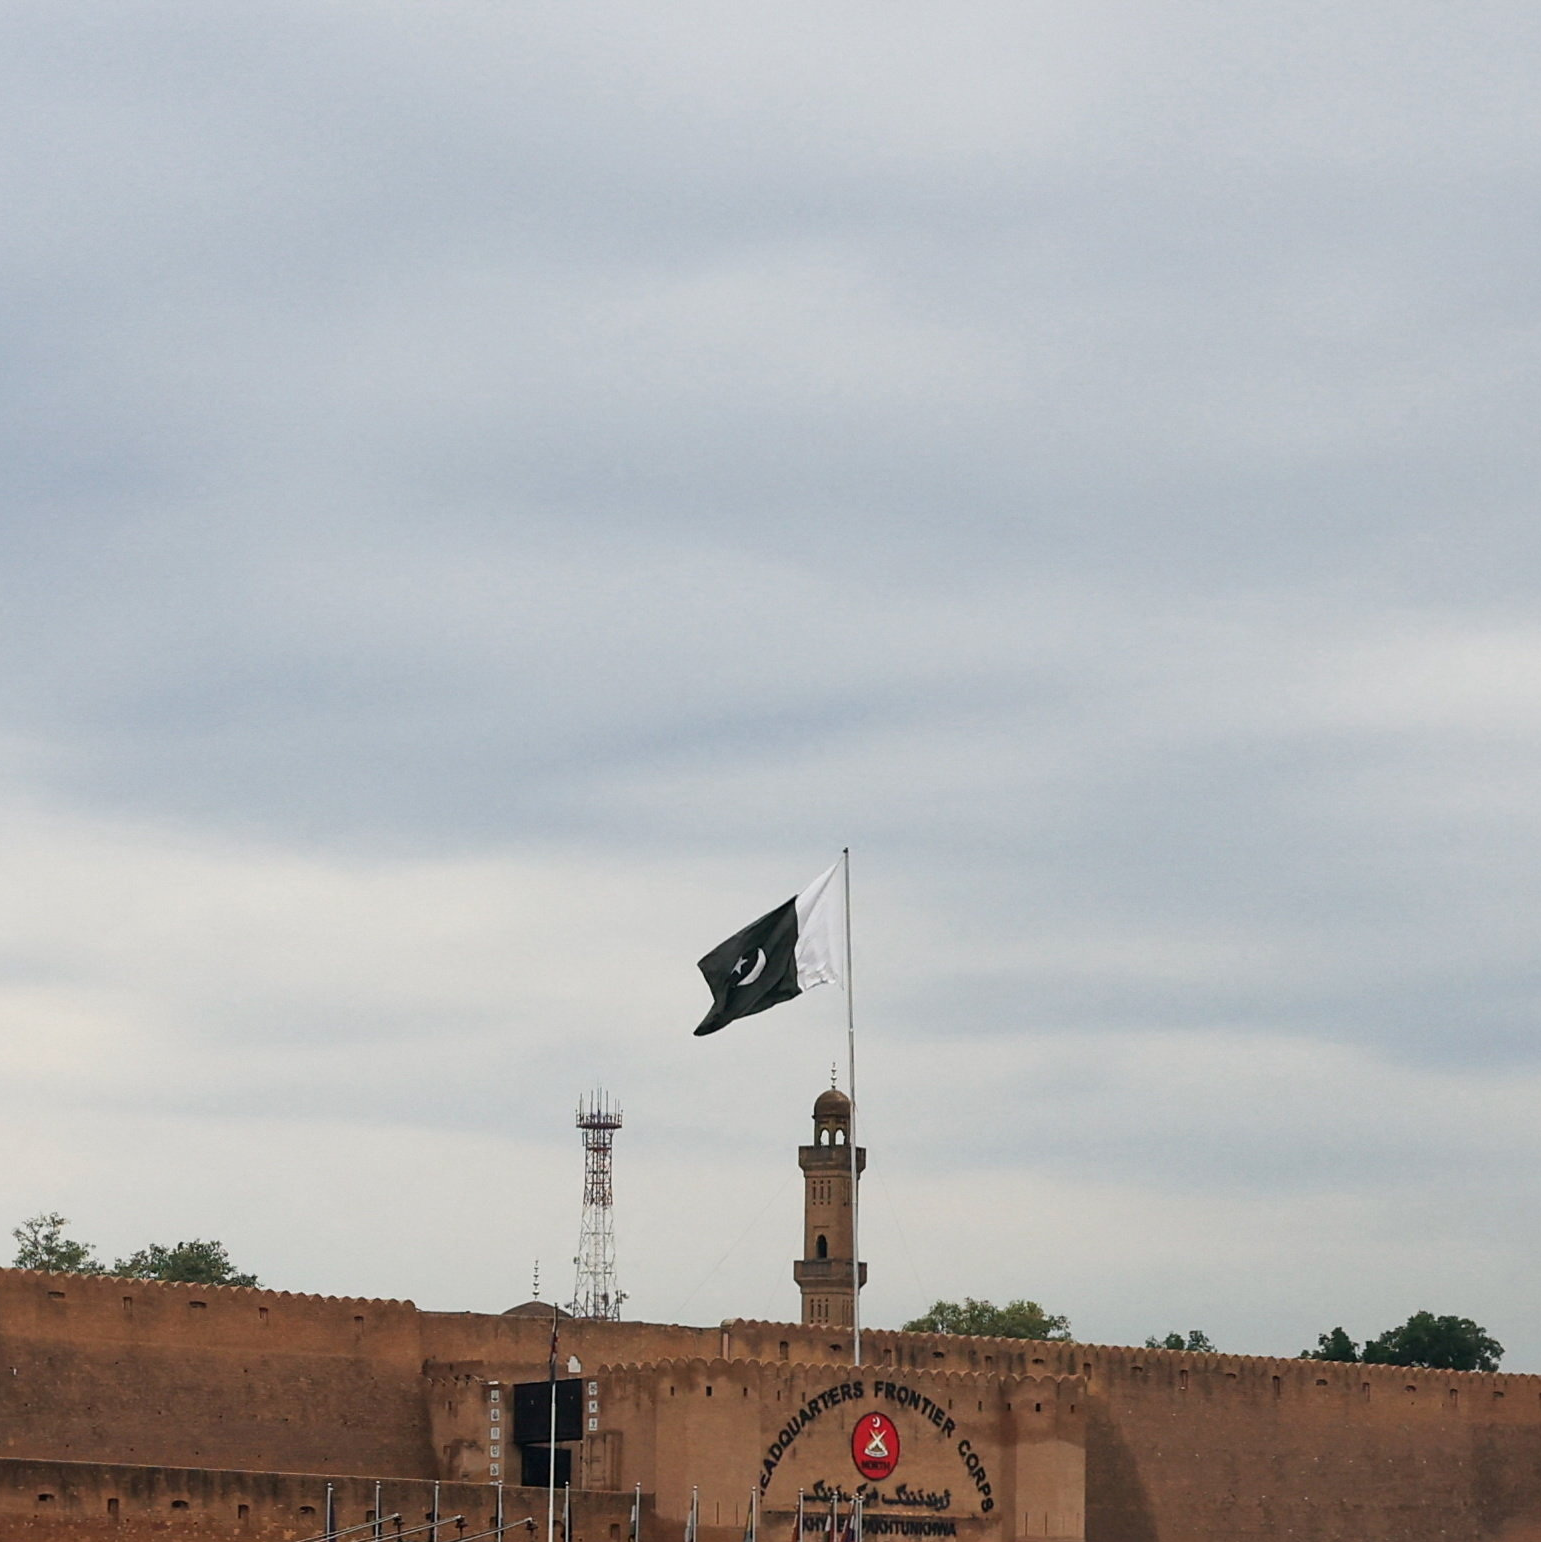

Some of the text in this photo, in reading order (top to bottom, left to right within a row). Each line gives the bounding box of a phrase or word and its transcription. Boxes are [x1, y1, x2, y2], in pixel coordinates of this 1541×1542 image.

[861, 1459, 891, 1471] NORTH
[874, 1380, 956, 1439] FRONTIER
[958, 1439, 995, 1513] CORPS
